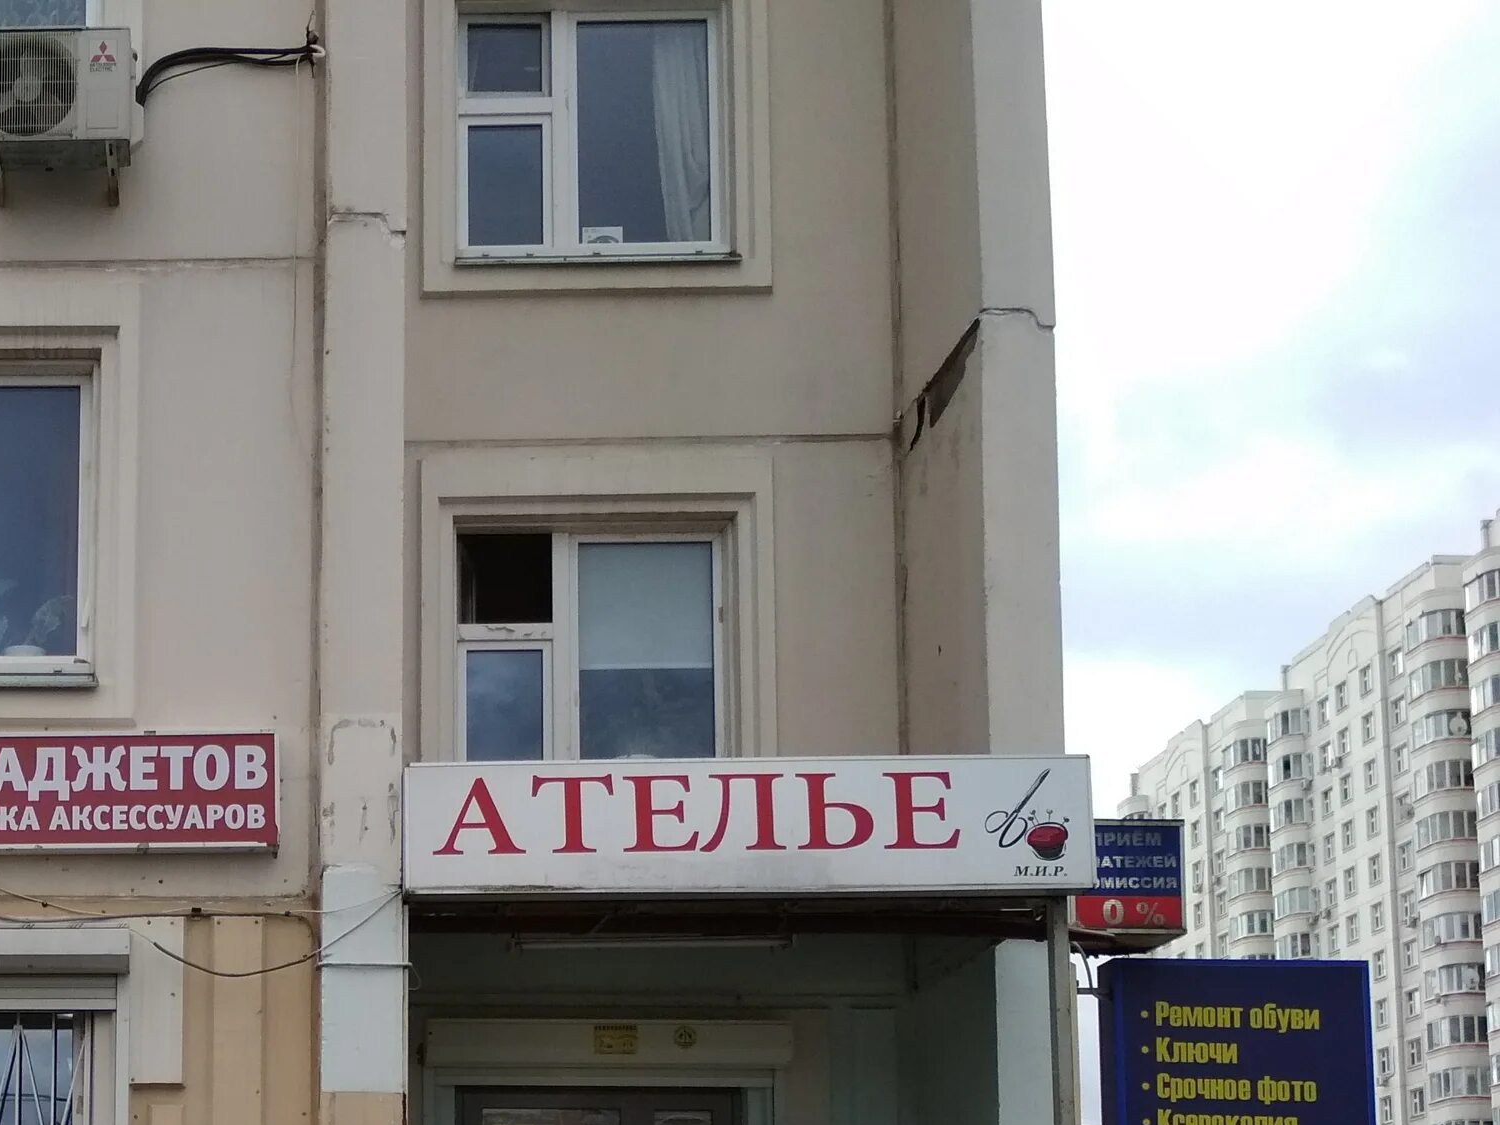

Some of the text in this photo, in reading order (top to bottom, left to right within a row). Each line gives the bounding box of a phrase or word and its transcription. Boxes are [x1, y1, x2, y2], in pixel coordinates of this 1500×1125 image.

[49, 804, 266, 831] АКСЕССУАРОВ
[433, 771, 961, 856] АТЕЛЬЕ
[1014, 865, 1068, 877] М.И.Р.
[1097, 853, 1177, 869] АТЕЖЕЙ
[1102, 898, 1166, 926] 0 %
[1155, 1001, 1320, 1033] Ремонт обуви
[1156, 1036, 1238, 1065] Ключи
[1156, 1073, 1318, 1106] Срочное фото
